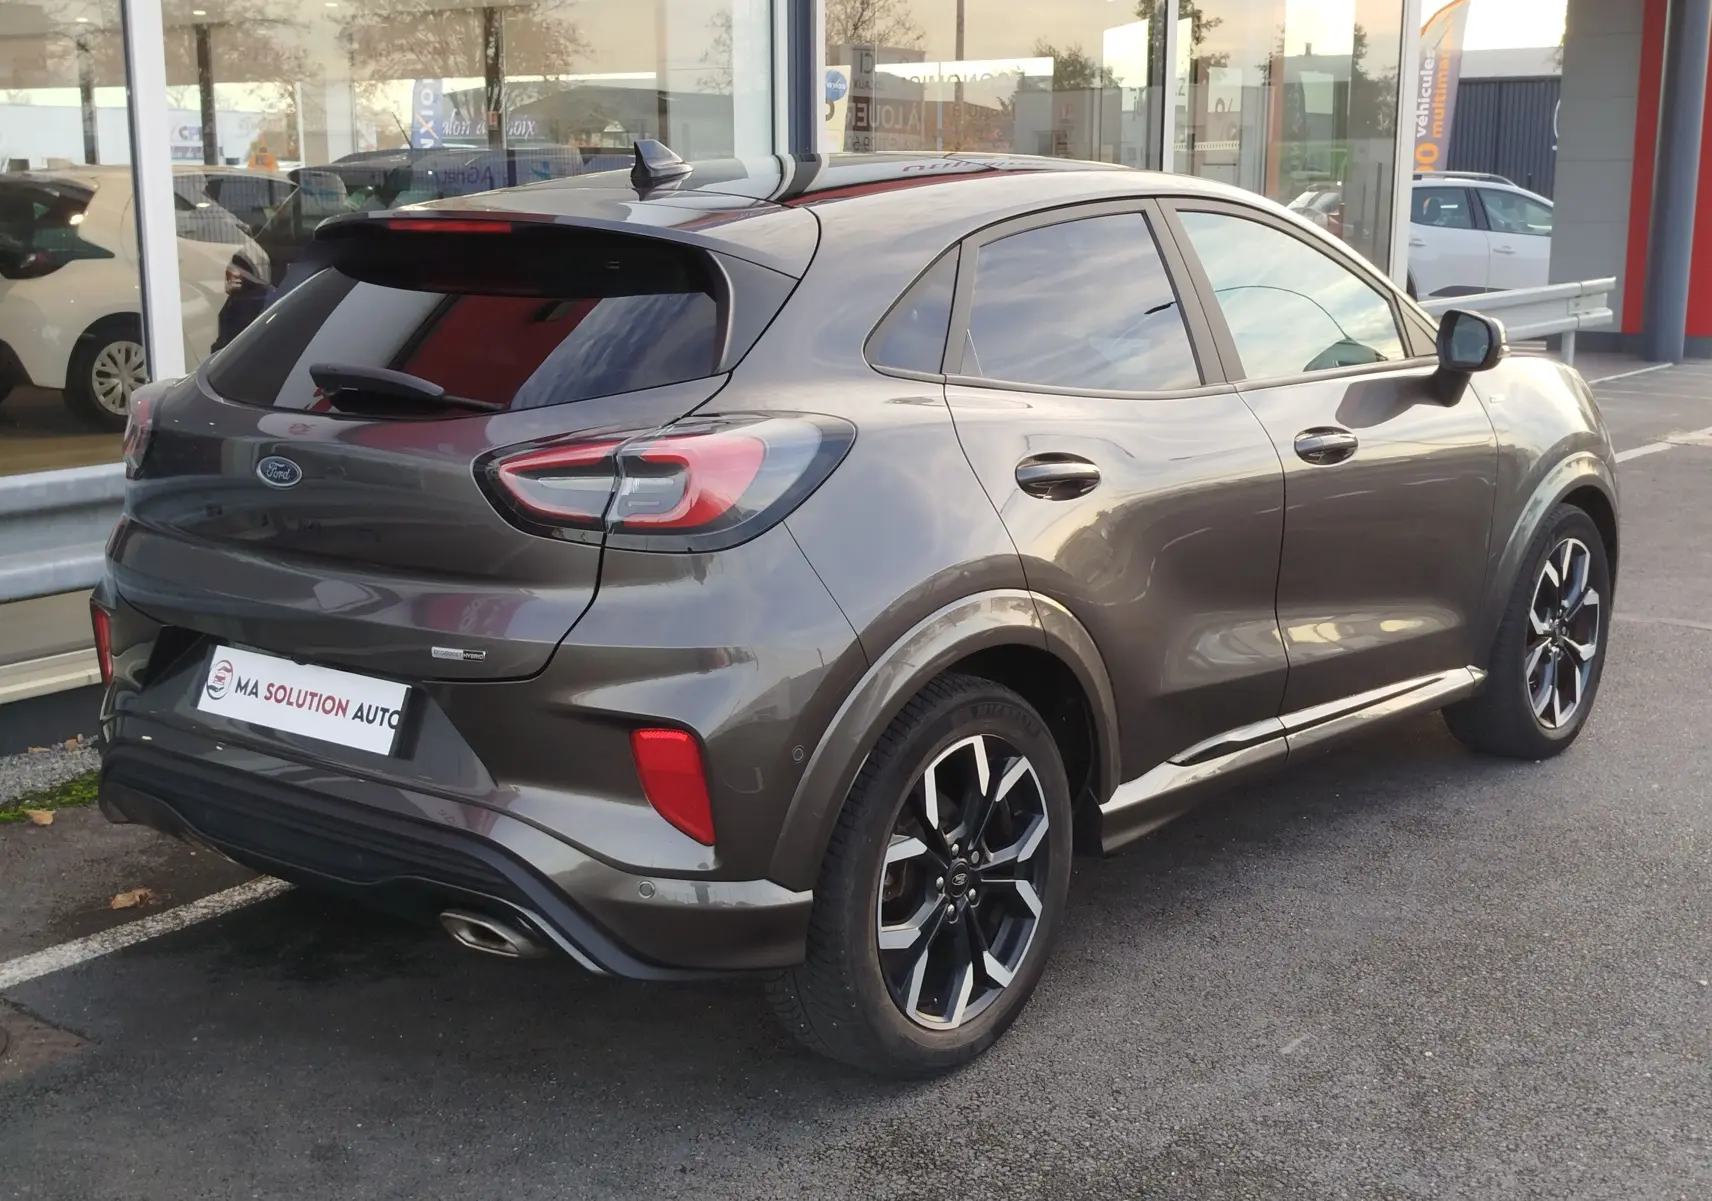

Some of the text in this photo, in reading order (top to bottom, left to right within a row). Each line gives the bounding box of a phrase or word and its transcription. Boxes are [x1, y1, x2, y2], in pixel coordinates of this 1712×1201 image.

[1416, 49, 1436, 138] véhicules
[266, 461, 292, 481] Ford
[234, 675, 402, 730] MA SOLUTION AUTO
